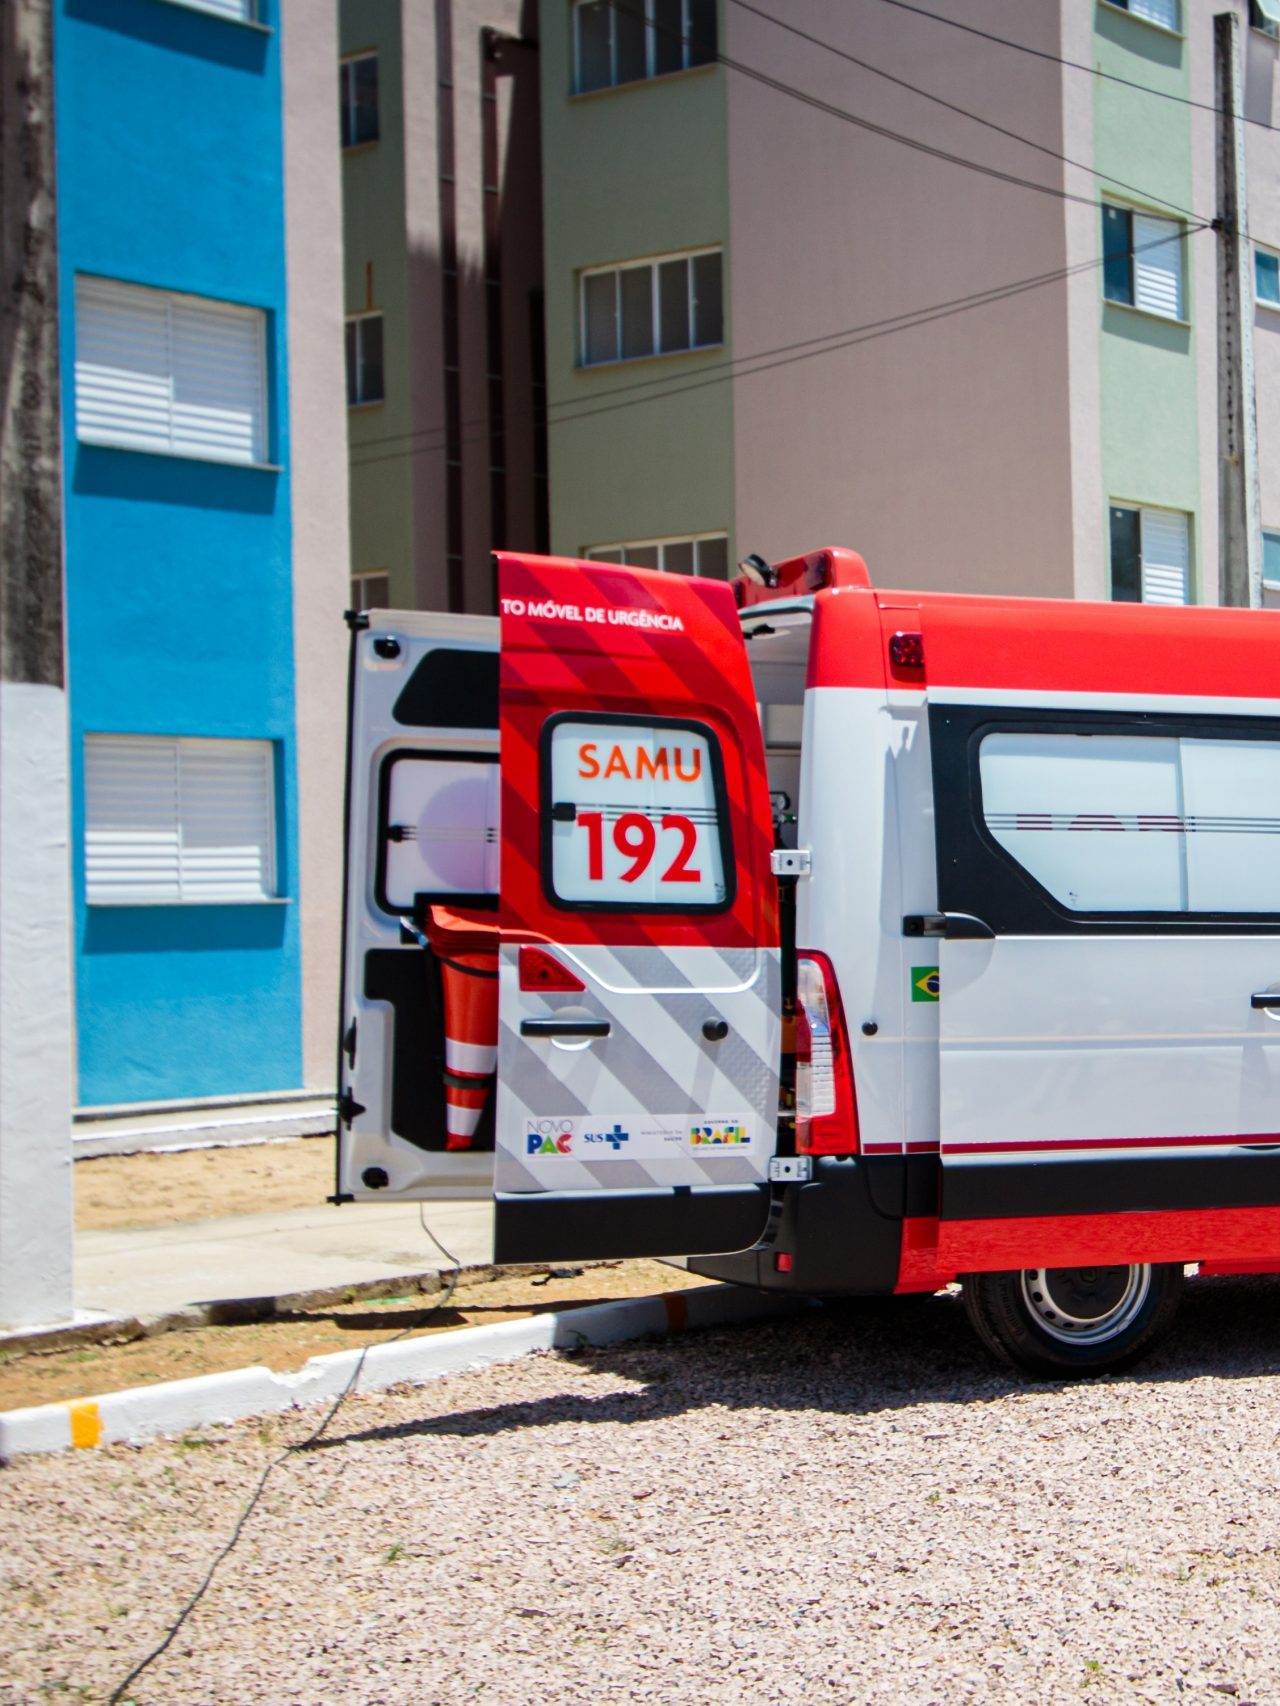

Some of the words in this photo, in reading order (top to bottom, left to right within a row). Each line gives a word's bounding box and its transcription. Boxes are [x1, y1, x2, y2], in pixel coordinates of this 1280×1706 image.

[501, 599, 526, 616] TO
[528, 600, 582, 621] MÓVEL
[585, 607, 605, 623] DE
[608, 610, 684, 631] URGÊNCIA
[577, 743, 702, 782] SAMU
[576, 811, 702, 883] 192
[526, 1119, 574, 1134] NOVO
[690, 1127, 751, 1145] BRASIL
[527, 1134, 572, 1154] PAC
[583, 1134, 604, 1143] SUS
